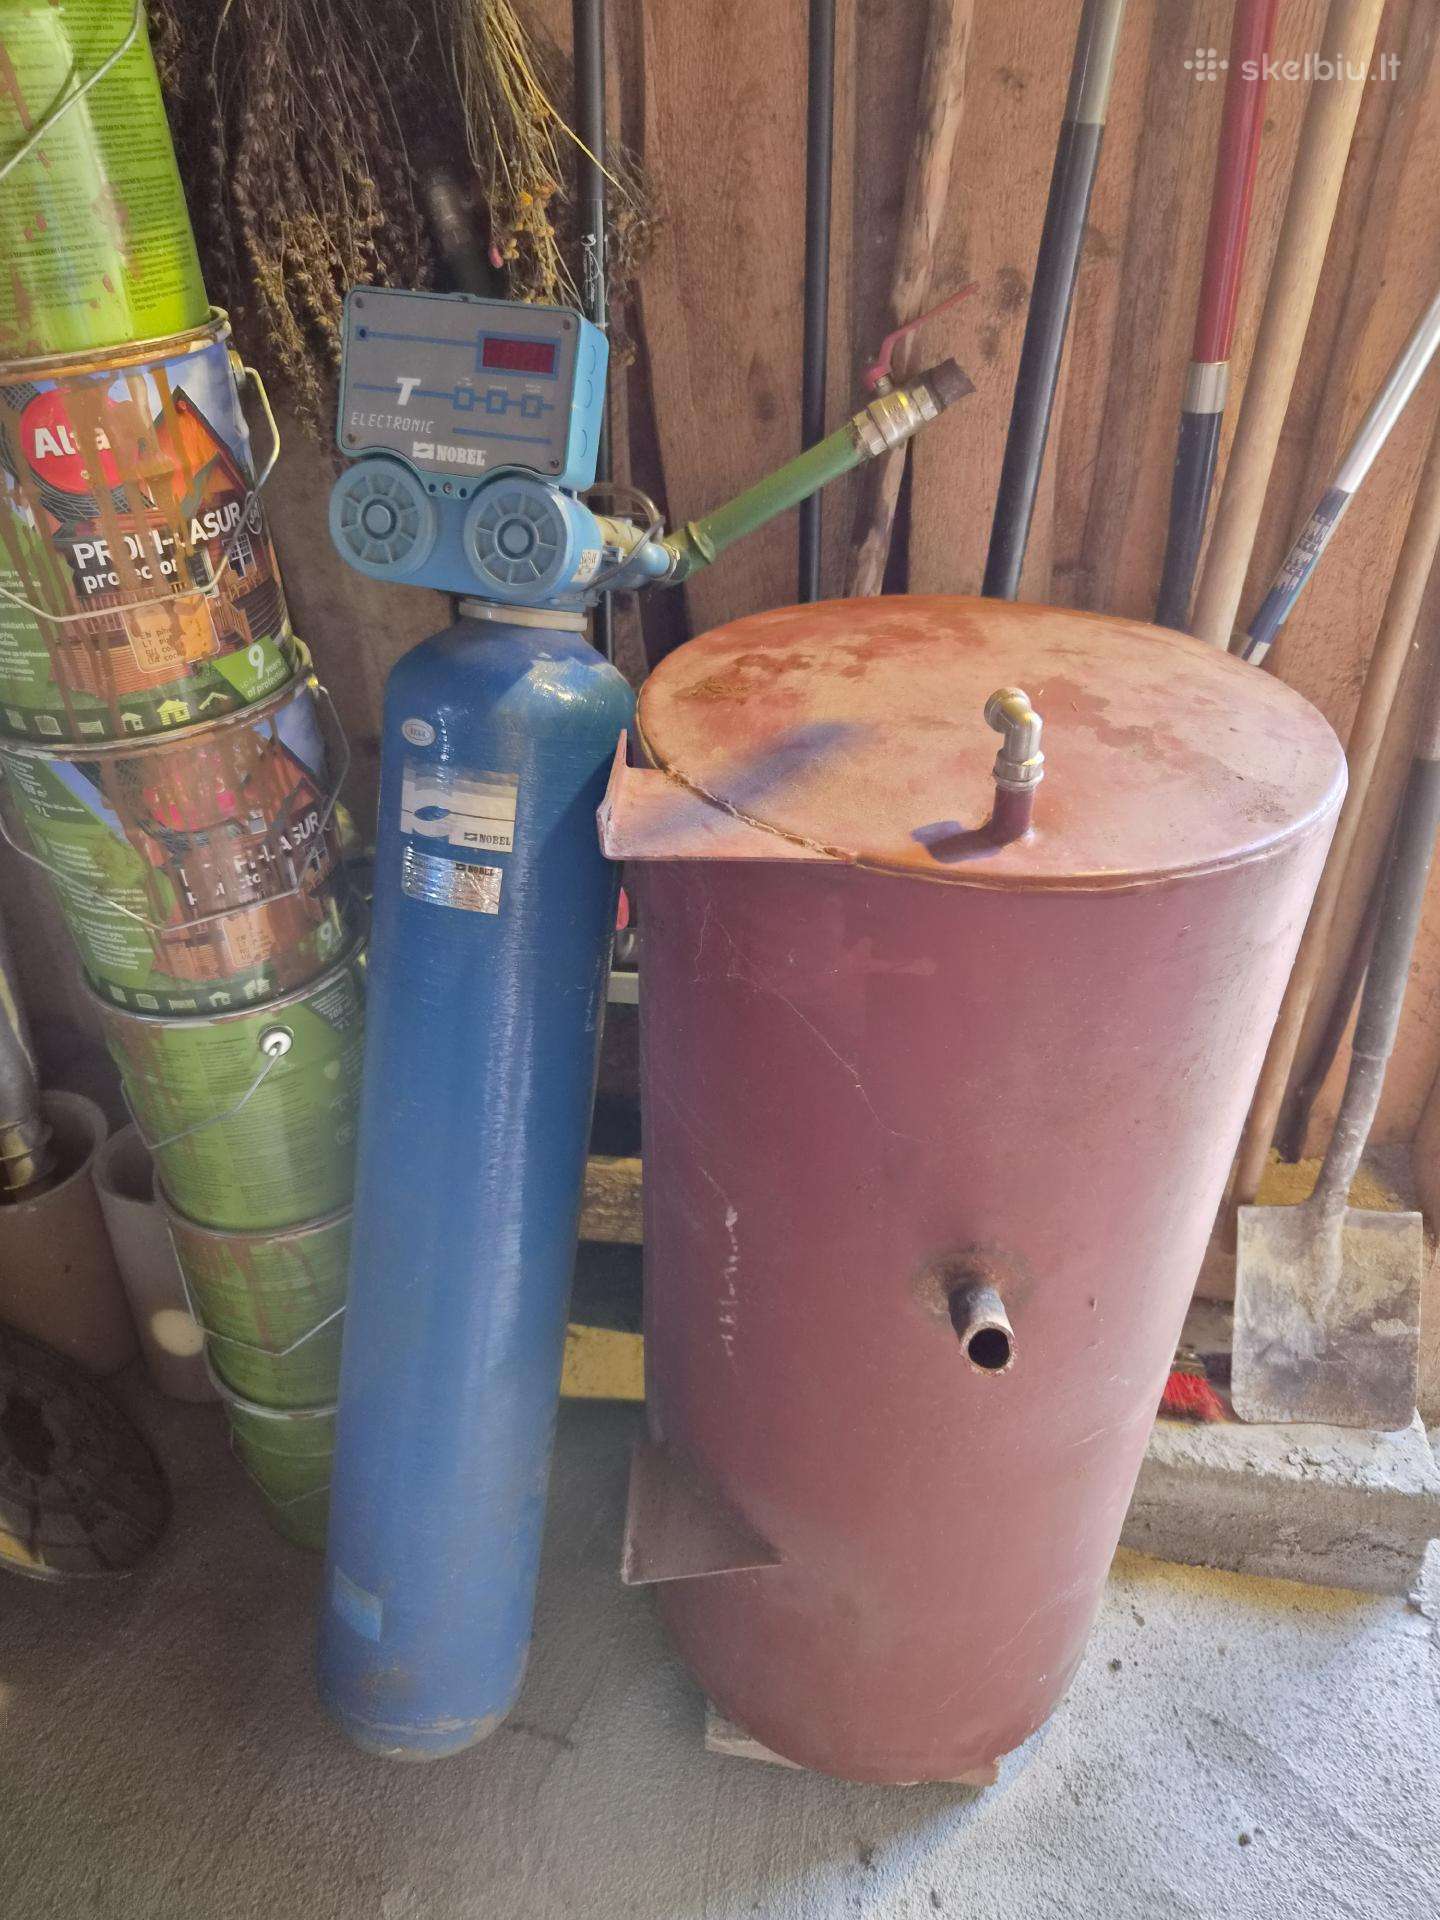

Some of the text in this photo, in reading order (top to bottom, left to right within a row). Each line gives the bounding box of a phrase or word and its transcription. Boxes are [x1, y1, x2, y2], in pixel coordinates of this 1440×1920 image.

[351, 412, 434, 434] ELECTRONIC
[436, 444, 487, 466] NOBEL
[248, 643, 264, 680] 9
[479, 833, 511, 846] NOBEL
